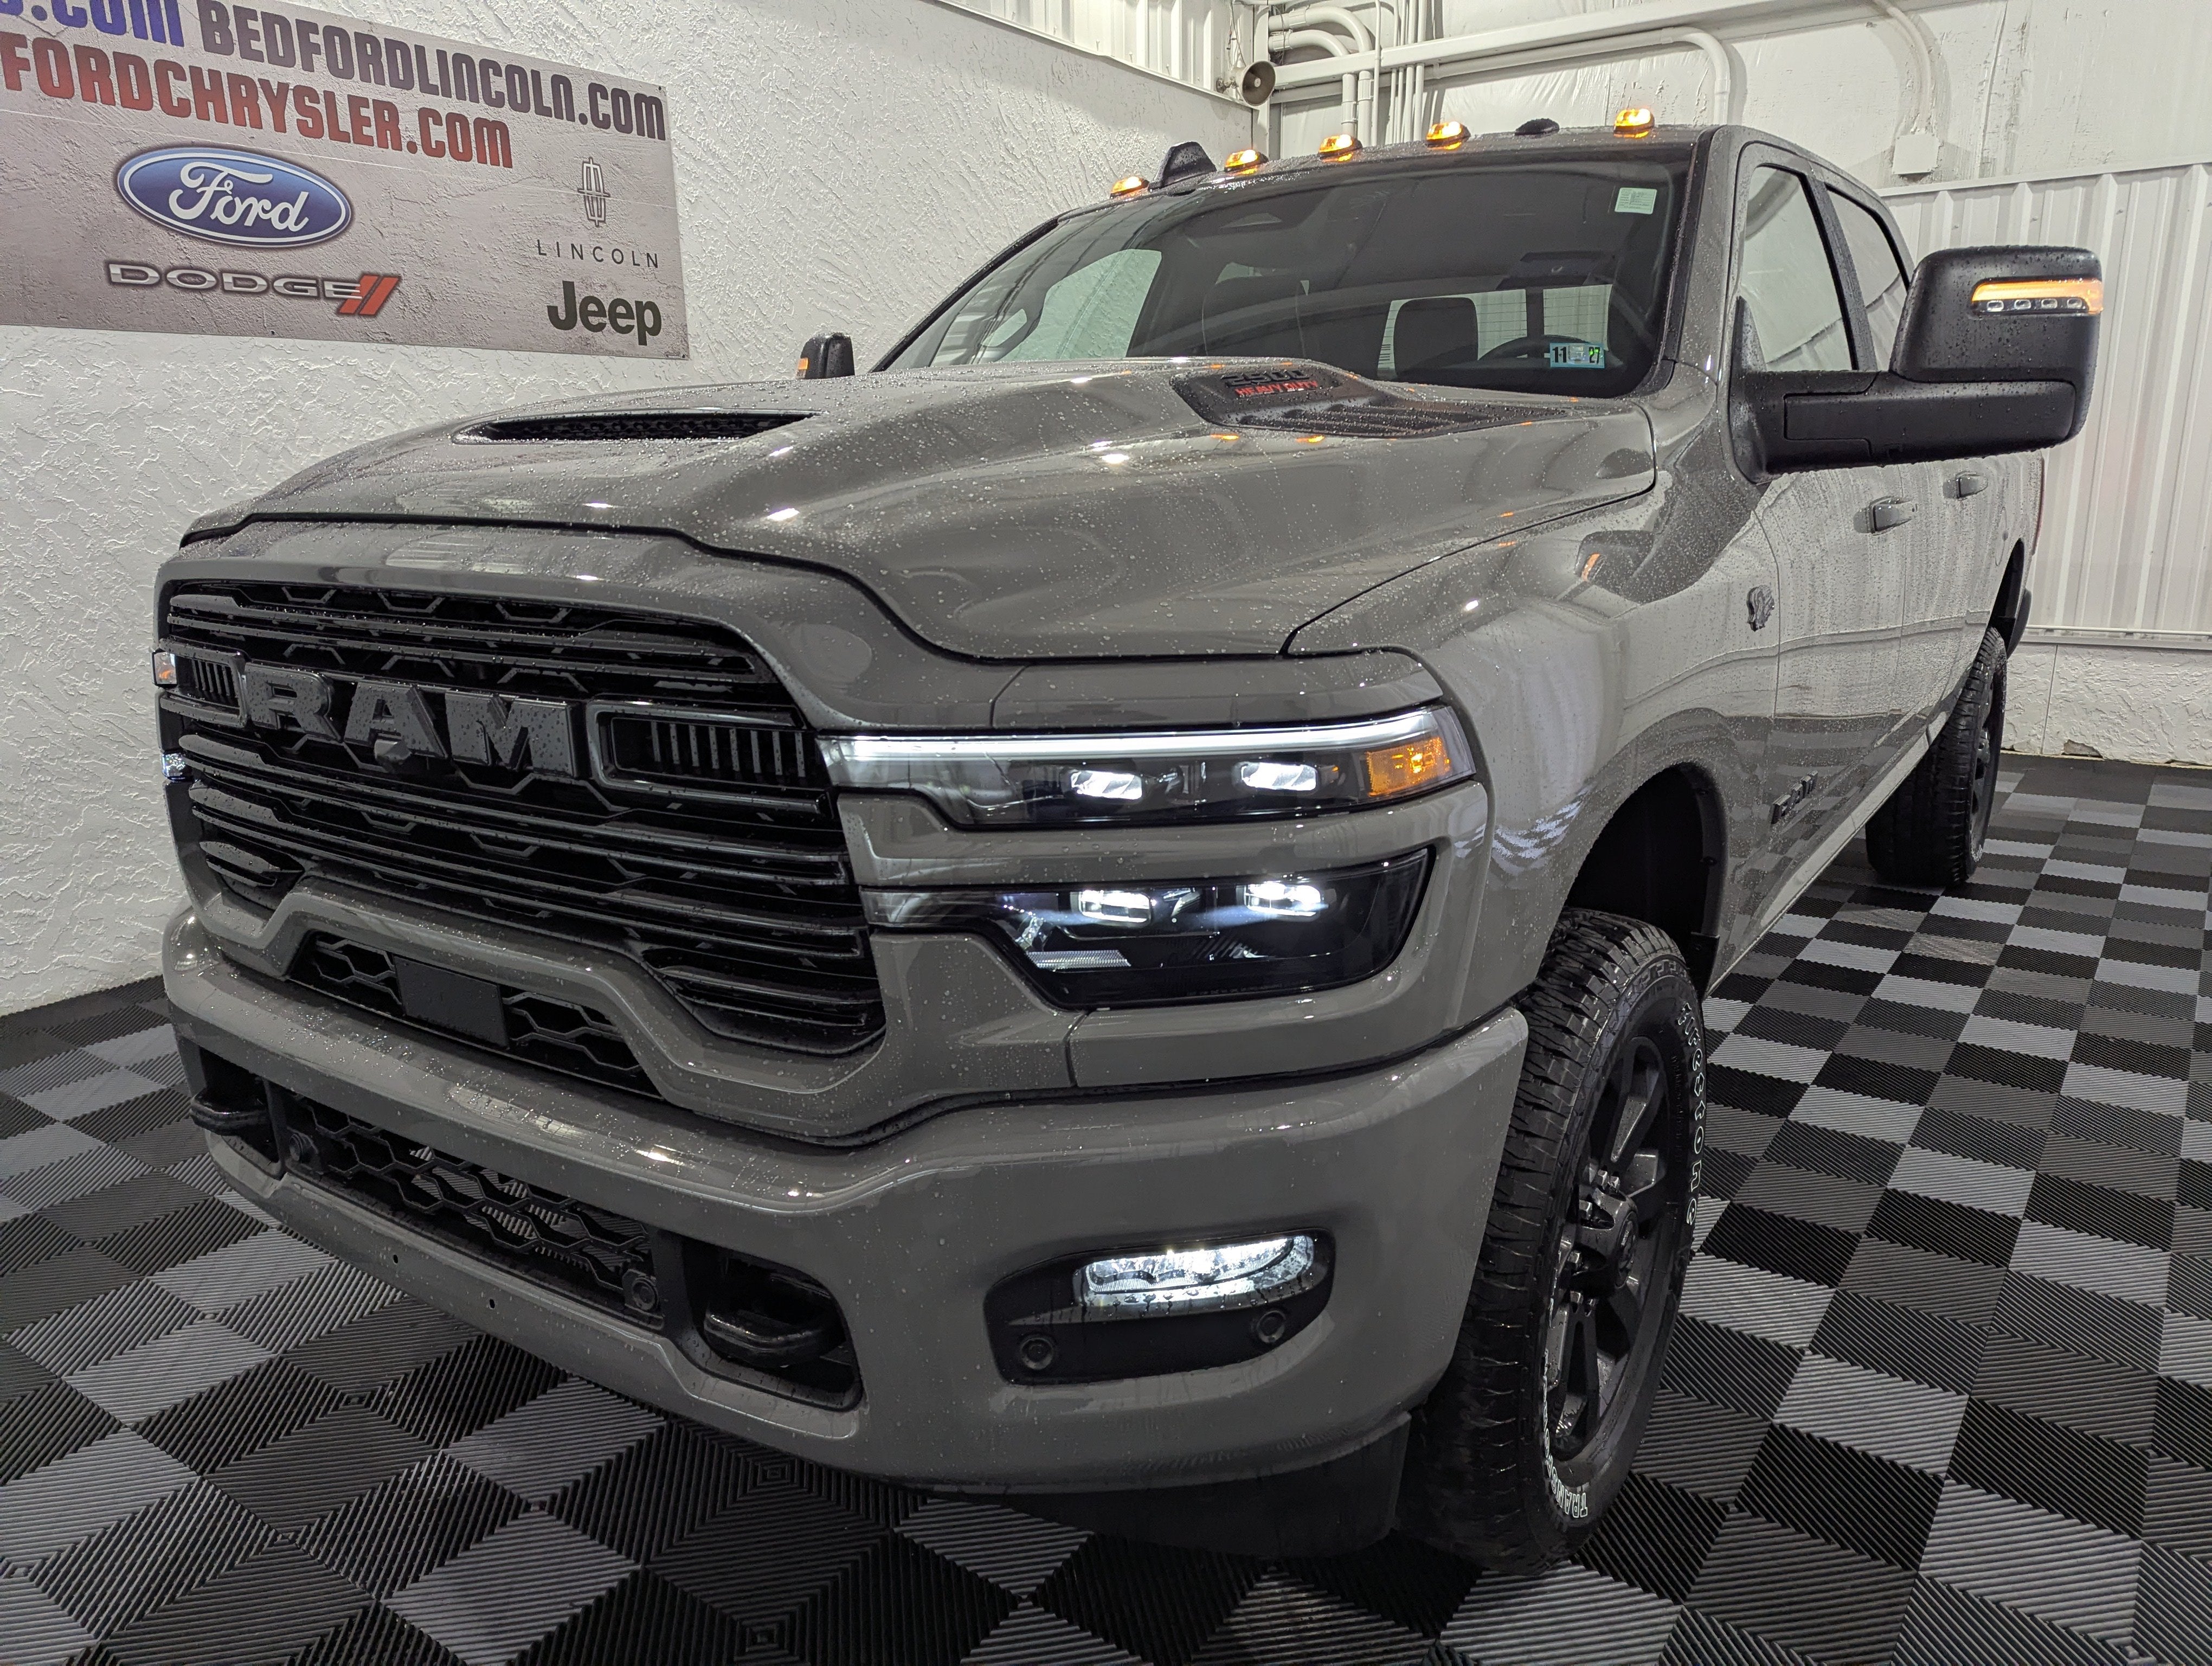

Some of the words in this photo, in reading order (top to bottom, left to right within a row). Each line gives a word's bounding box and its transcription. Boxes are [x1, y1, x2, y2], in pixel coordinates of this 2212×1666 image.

[169, 162, 310, 232] Ford
[537, 239, 658, 268] LINCOLN
[108, 264, 363, 300] DODGE
[546, 280, 662, 346] Jeep
[1552, 347, 1567, 363] 11
[1221, 369, 1310, 388] 2500
[1234, 384, 1283, 398] HEAVY
[1283, 380, 1318, 392] DUTY
[245, 662, 580, 778] RAM
